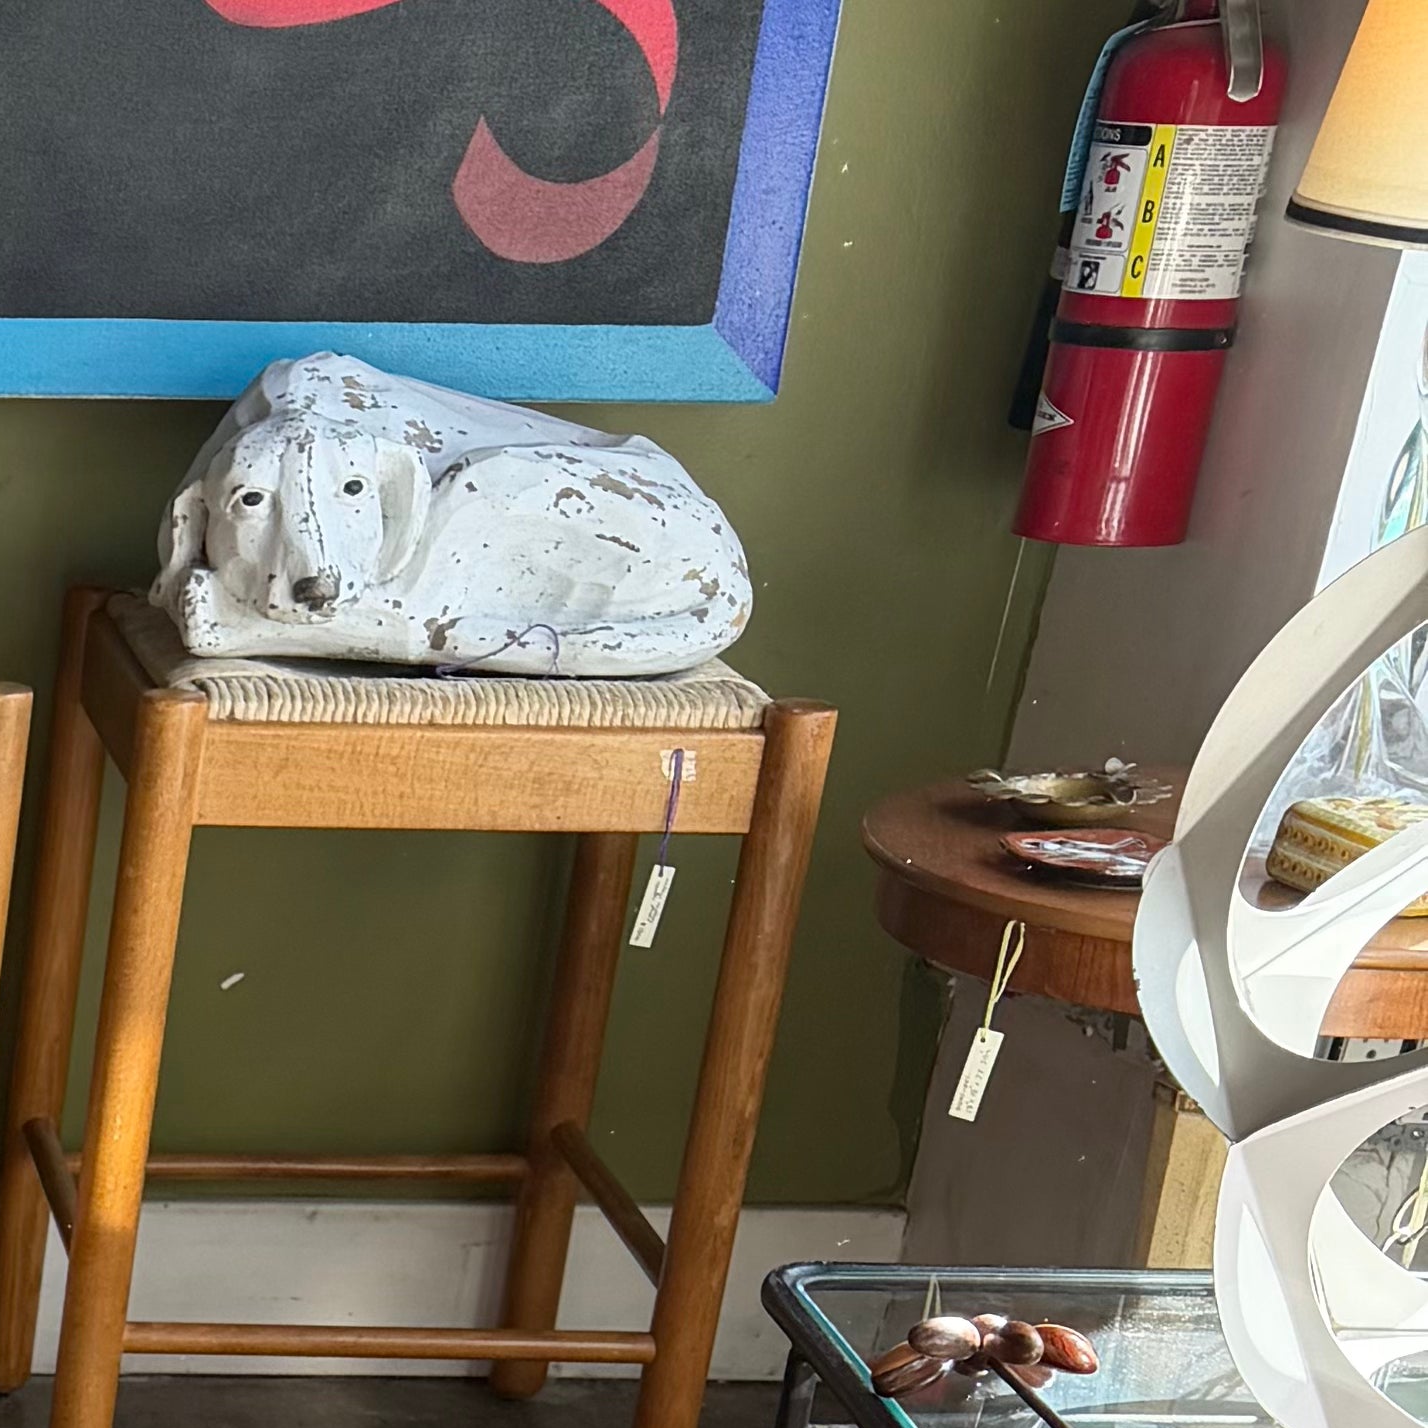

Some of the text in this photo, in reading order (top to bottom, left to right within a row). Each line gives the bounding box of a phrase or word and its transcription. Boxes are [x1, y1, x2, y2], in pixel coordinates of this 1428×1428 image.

[1153, 144, 1165, 167] A
[1142, 200, 1155, 223] B
[1131, 255, 1143, 278] C
